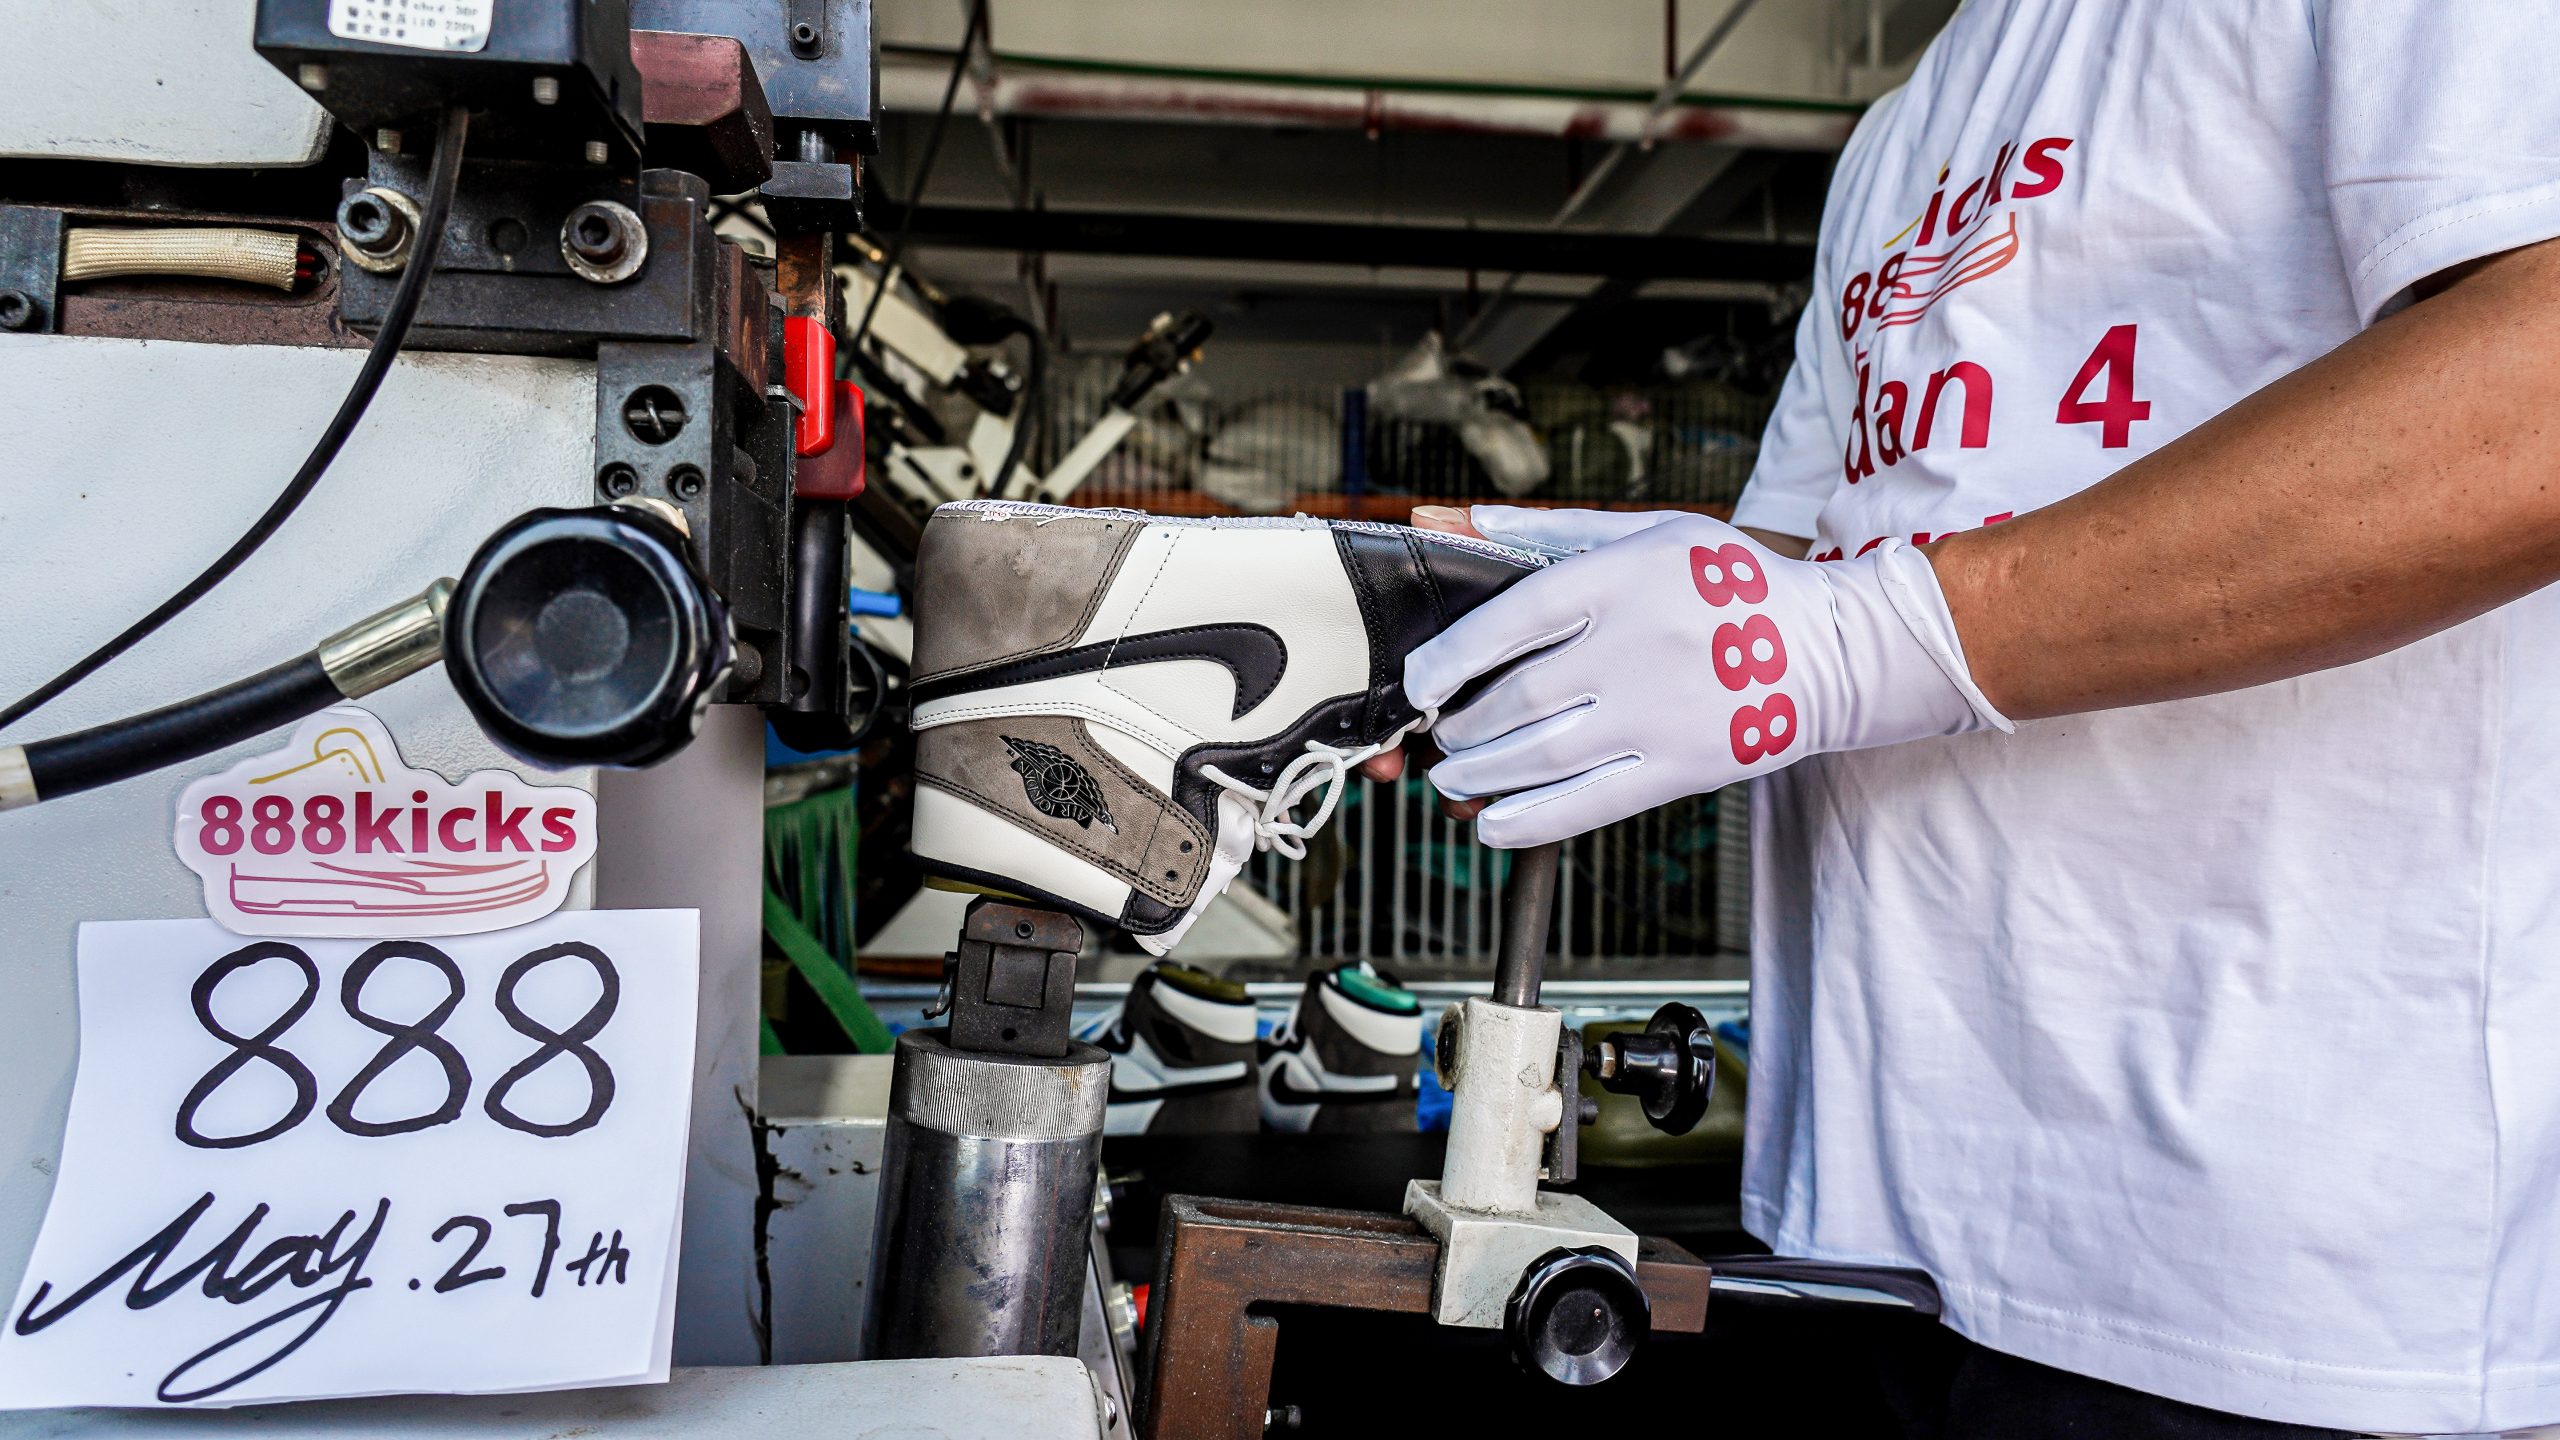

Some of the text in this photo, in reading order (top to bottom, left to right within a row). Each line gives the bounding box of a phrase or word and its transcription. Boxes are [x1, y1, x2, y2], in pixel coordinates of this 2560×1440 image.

[1842, 137, 2074, 342] 88icks
[2056, 324, 2151, 449] 4
[1689, 542, 1797, 766] 888
[199, 789, 578, 856] 888kicks
[1060, 803, 1089, 821] AIR
[175, 940, 621, 1149] 888
